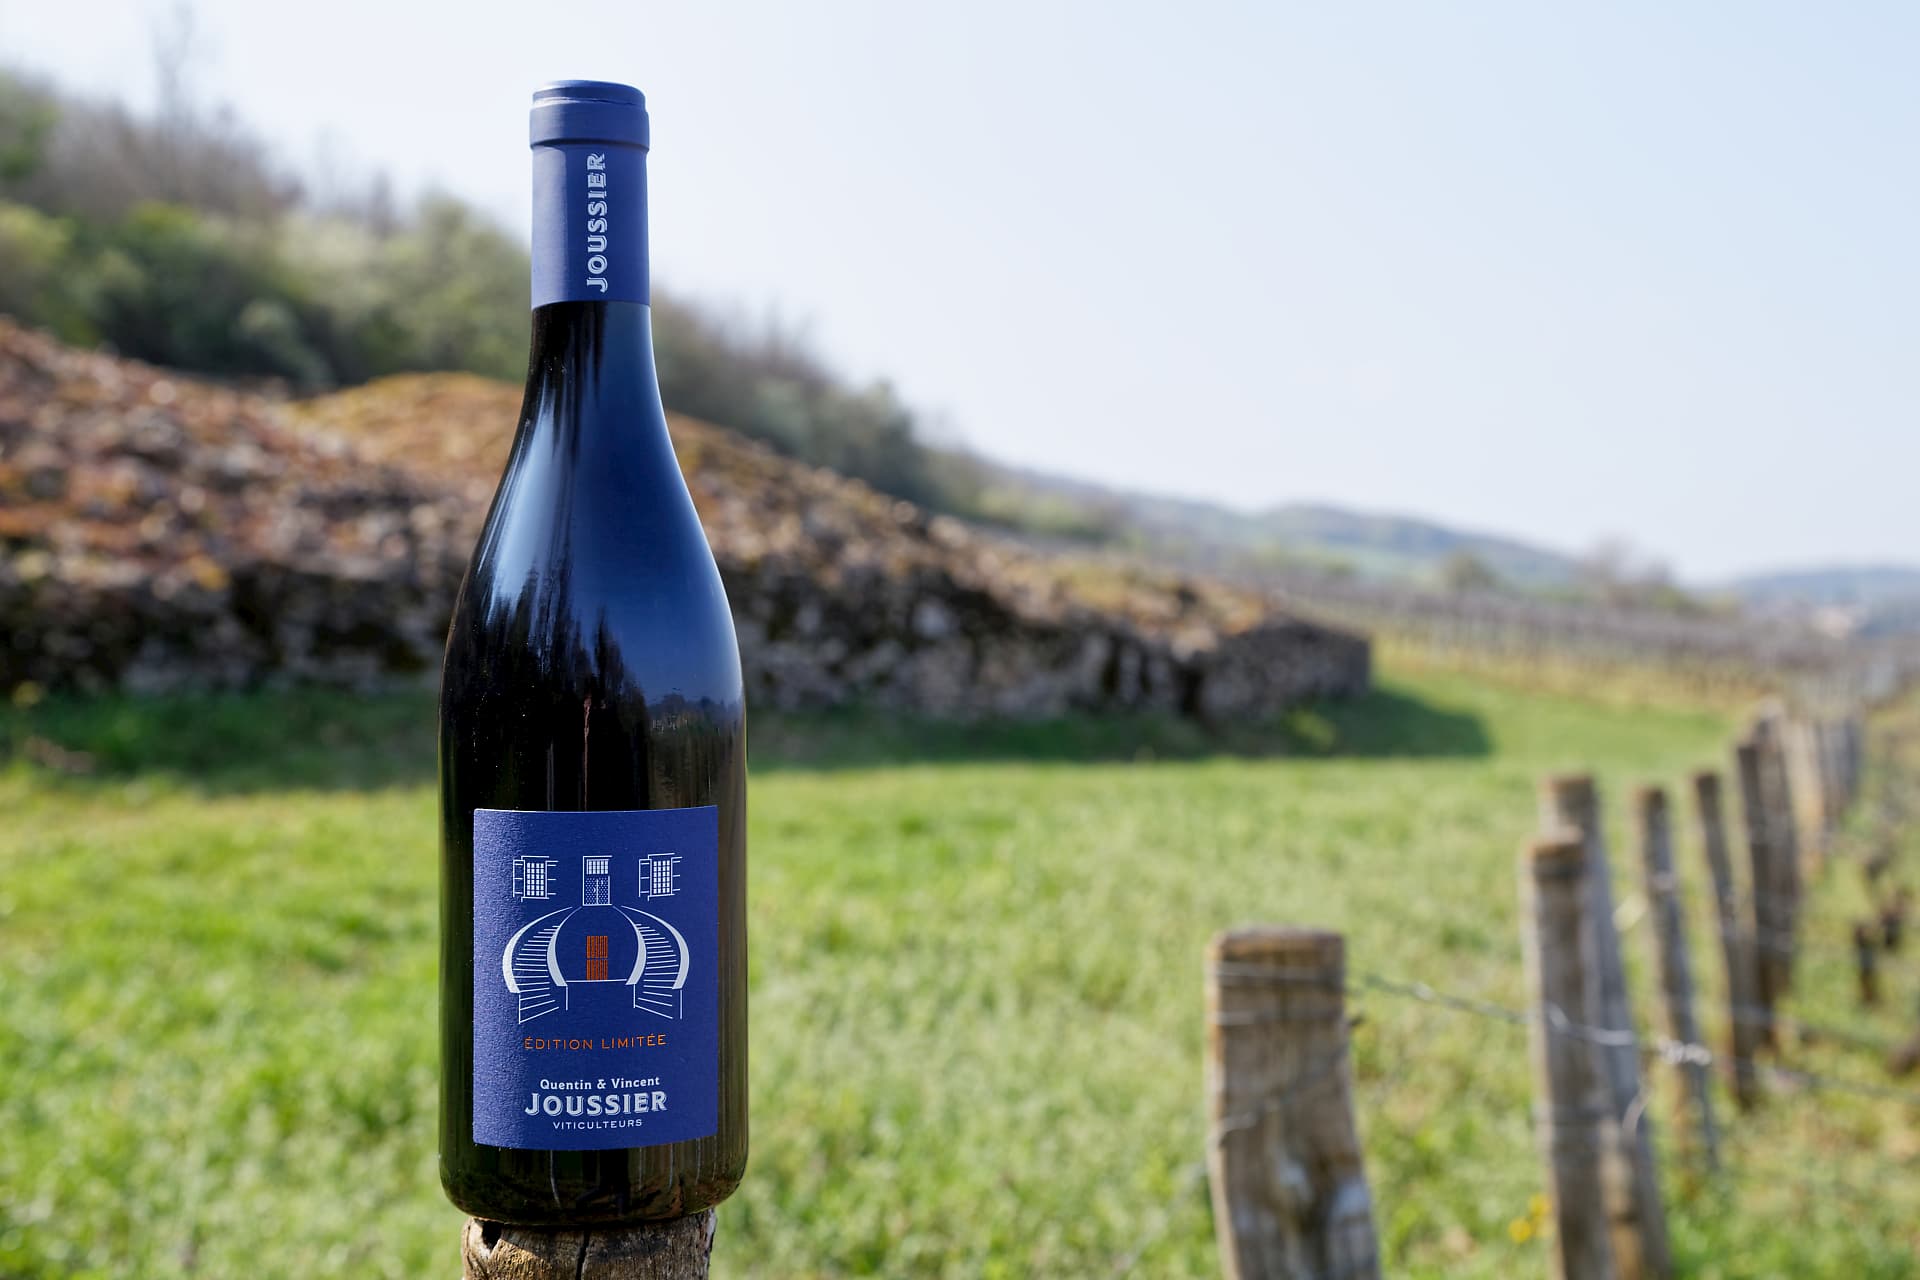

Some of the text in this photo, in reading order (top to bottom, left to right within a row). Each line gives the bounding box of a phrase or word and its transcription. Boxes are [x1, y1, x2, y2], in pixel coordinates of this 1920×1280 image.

[586, 152, 608, 293] JOUSSIER
[524, 1033, 667, 1050] ÉDITION LIMITÉE
[540, 1077, 660, 1090] Quentin & Vincent
[524, 1091, 668, 1116] JOUSSIER
[553, 1119, 642, 1130] VITICULTEURS
